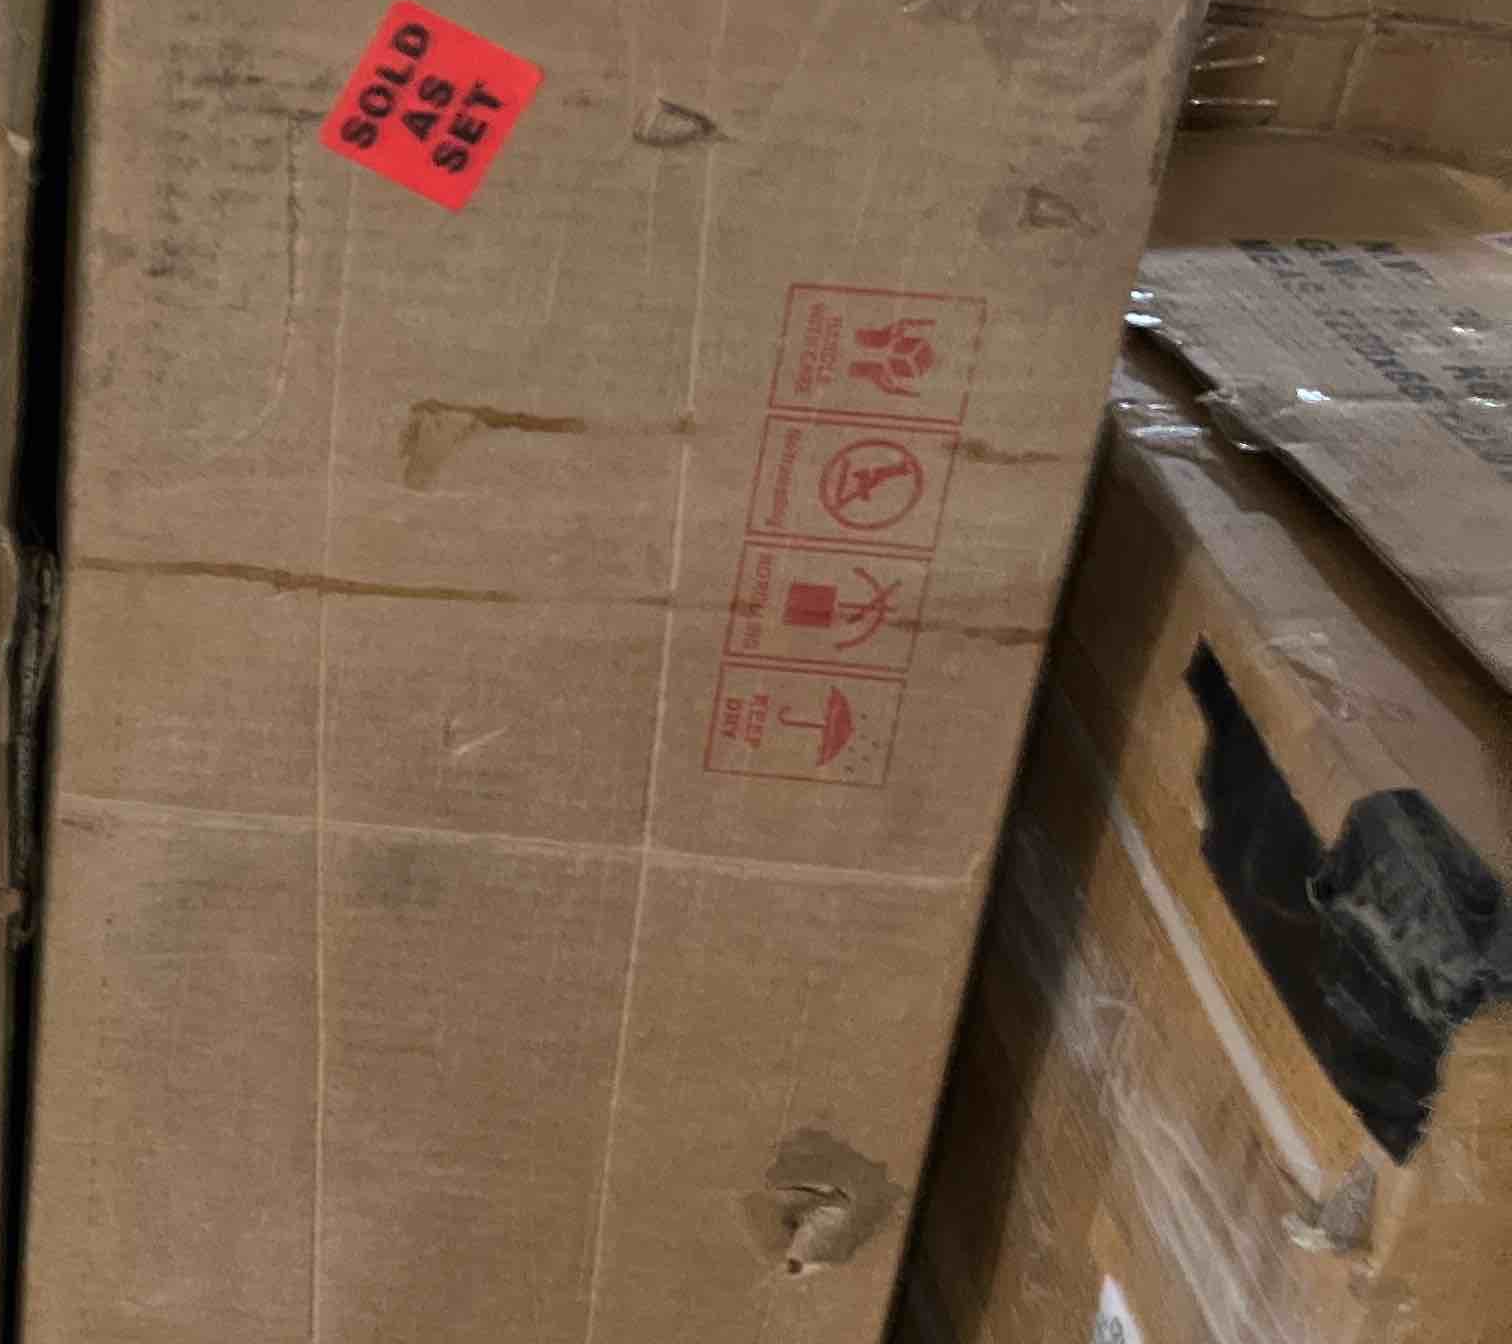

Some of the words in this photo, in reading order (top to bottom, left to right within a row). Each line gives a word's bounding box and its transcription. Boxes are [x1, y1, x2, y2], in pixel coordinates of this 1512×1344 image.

[339, 22, 430, 150] SOLD
[401, 75, 455, 142] AS
[431, 80, 505, 174] SET
[720, 697, 745, 738] DRY
[743, 694, 769, 747] KEEP
